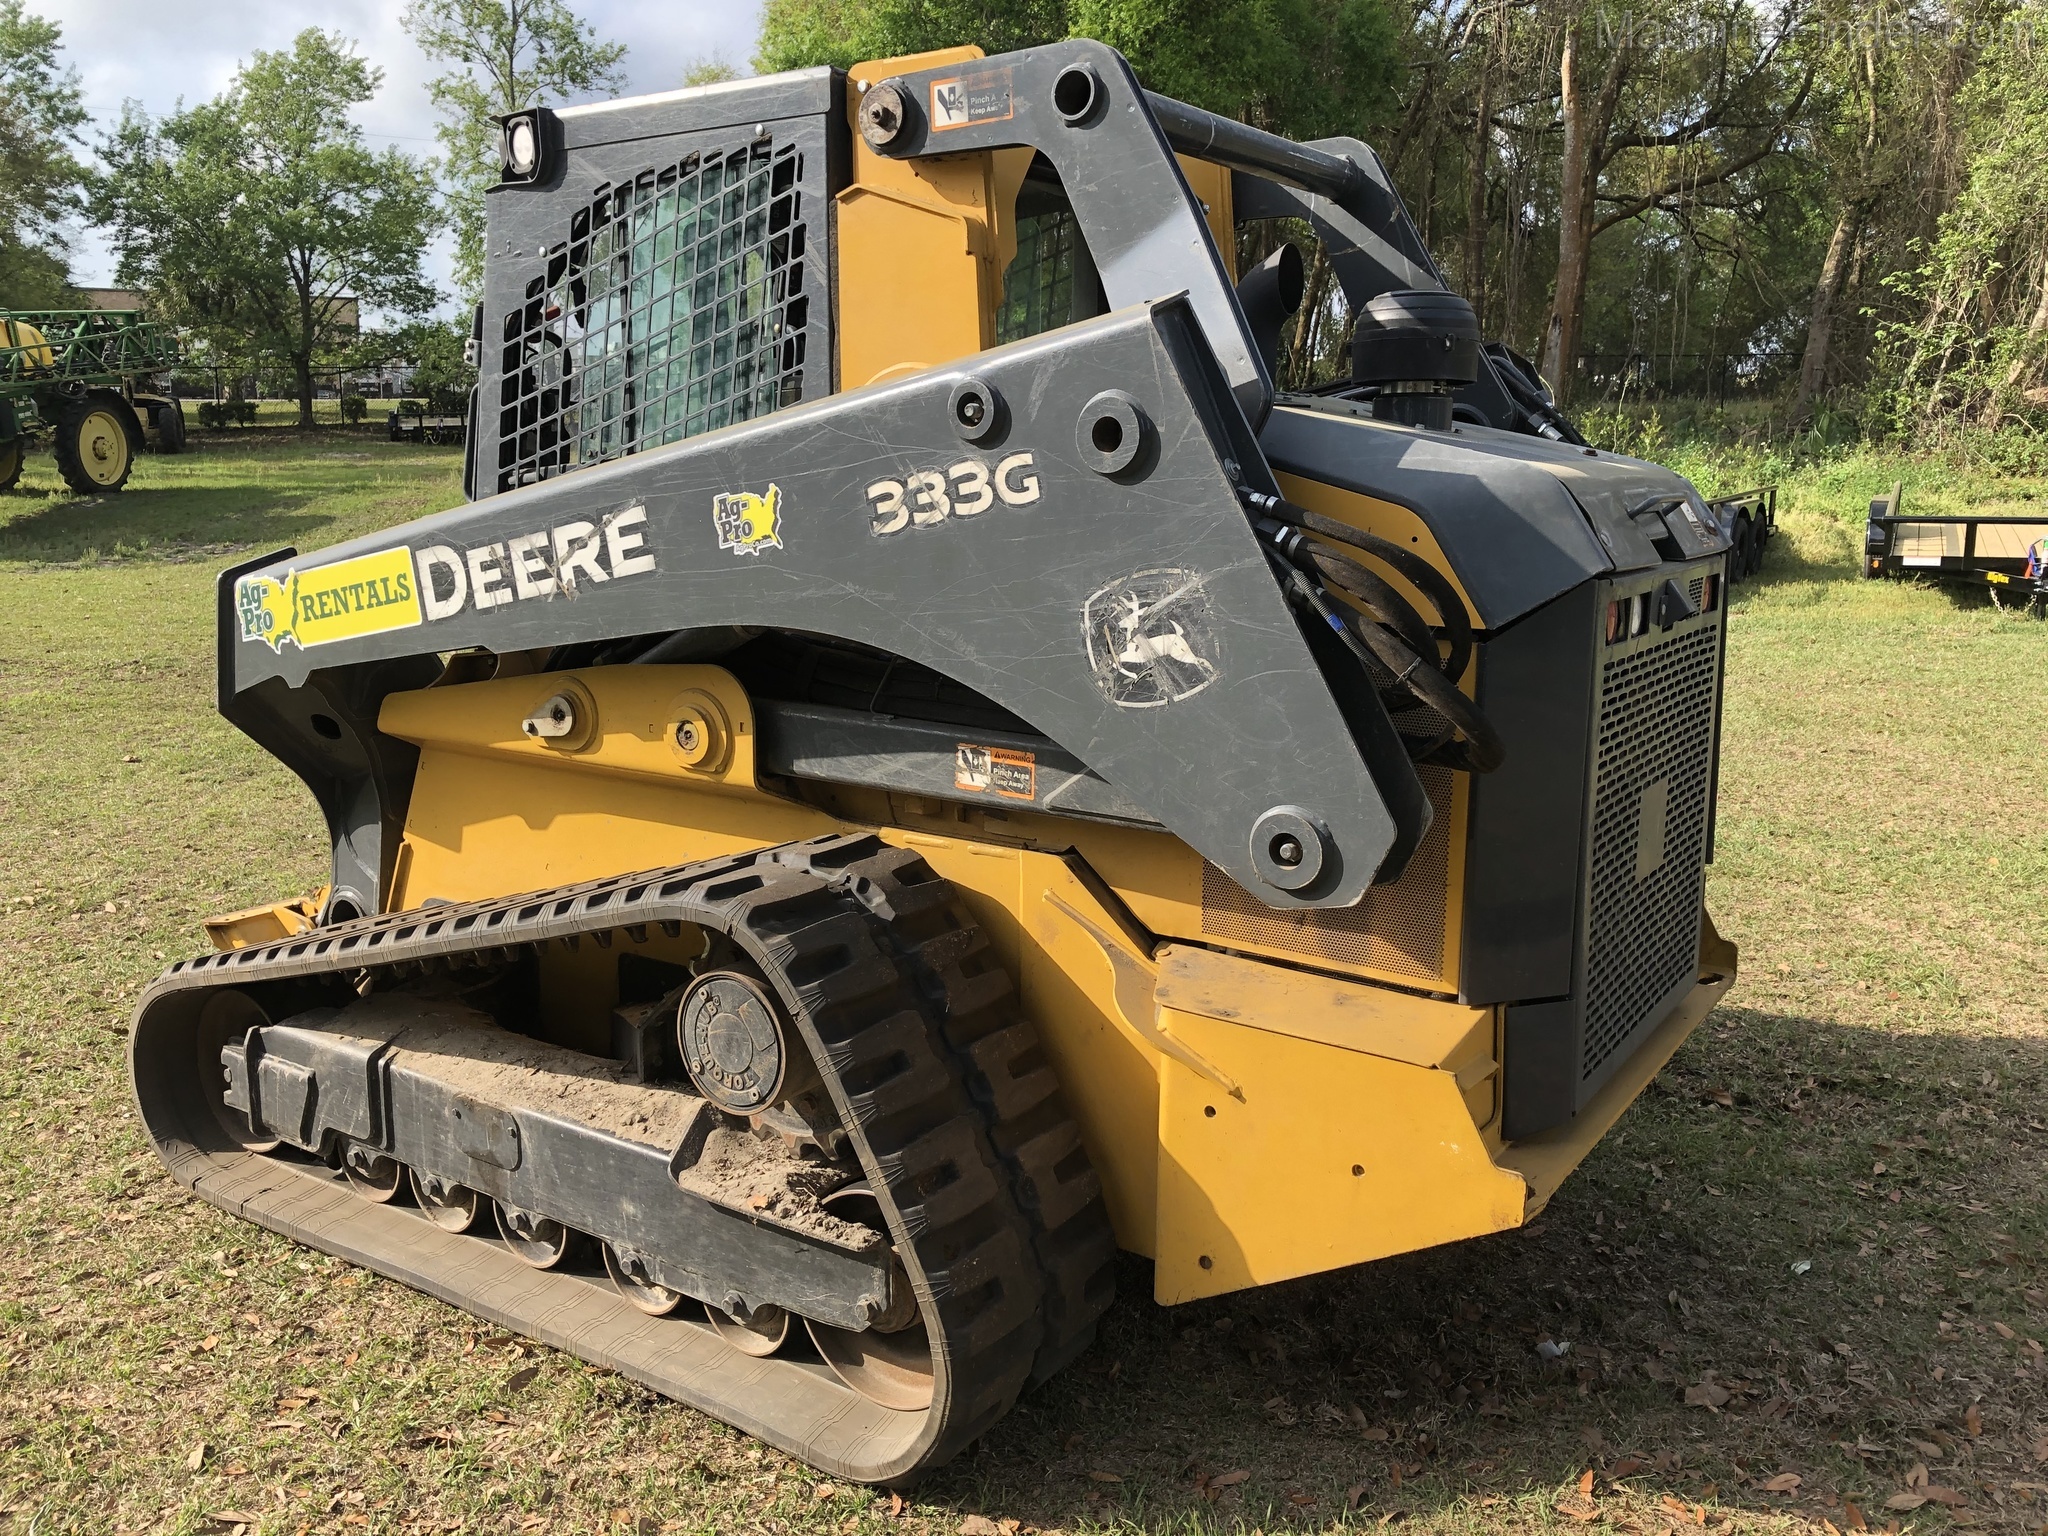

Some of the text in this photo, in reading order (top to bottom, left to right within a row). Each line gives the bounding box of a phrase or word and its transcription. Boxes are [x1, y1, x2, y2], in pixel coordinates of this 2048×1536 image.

[971, 95, 990, 105] Pinch
[971, 107, 986, 115] Keep
[867, 453, 1040, 534] 333G
[721, 520, 753, 543] Pro
[415, 504, 656, 621] DEERE
[301, 572, 411, 623] RENTALS
[242, 607, 274, 637] Pro
[1001, 753, 1031, 763] WARNING
[993, 767, 1030, 780] Pinch Area
[1008, 780, 1025, 790] Away
